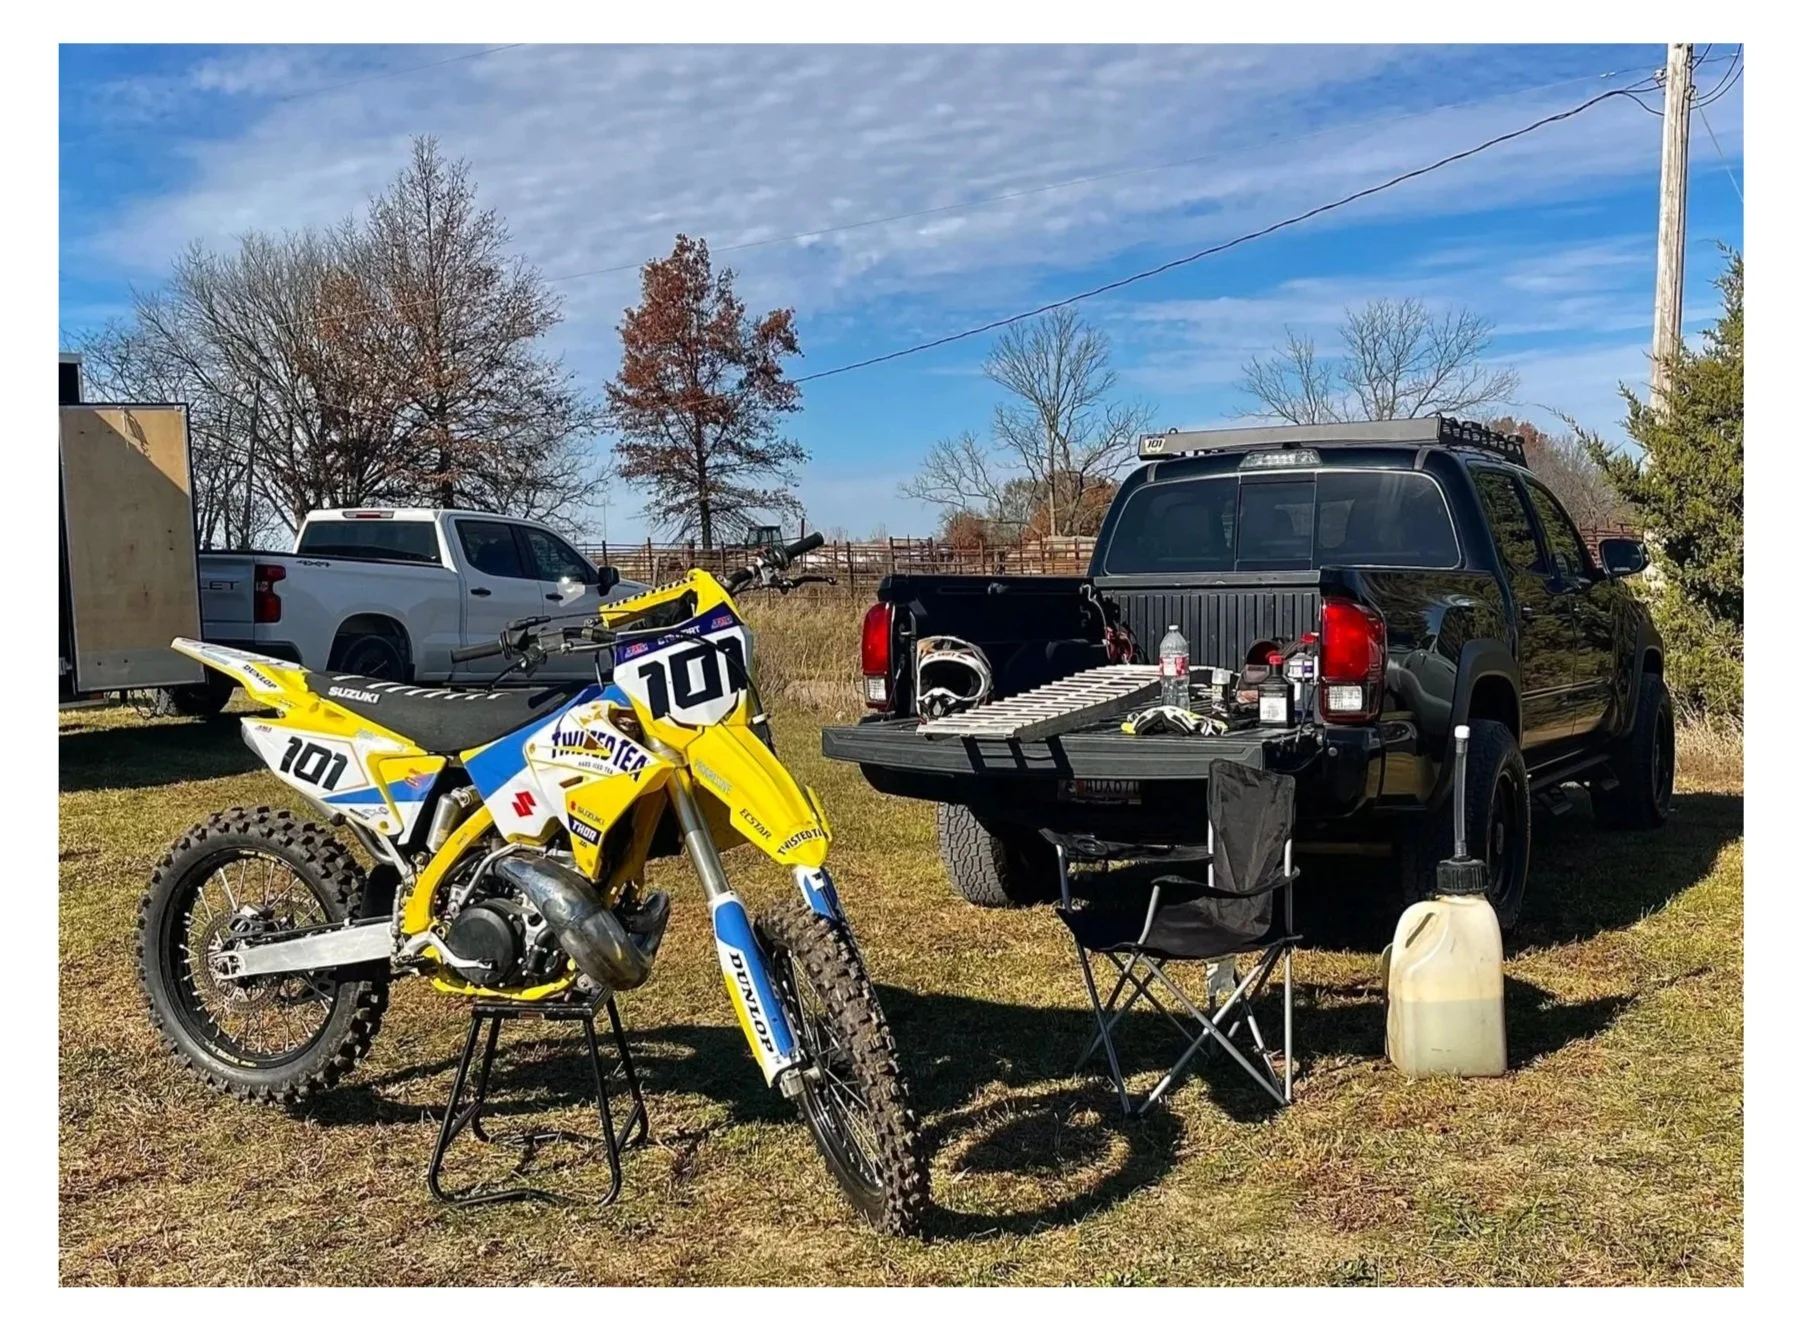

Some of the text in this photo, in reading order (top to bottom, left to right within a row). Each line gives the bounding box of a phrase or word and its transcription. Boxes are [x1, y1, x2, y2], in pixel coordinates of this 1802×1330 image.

[1147, 440, 1163, 448] 101
[243, 664, 277, 690] DUNLOP
[638, 636, 748, 720] 101
[328, 686, 380, 704] SUZUKI
[279, 736, 348, 791] 101
[552, 730, 648, 782] TWIED TEA
[572, 819, 598, 842] THOR
[740, 808, 772, 839] ECSTAR
[777, 832, 813, 856] TWISTED
[729, 952, 774, 1053] DUNLOP
